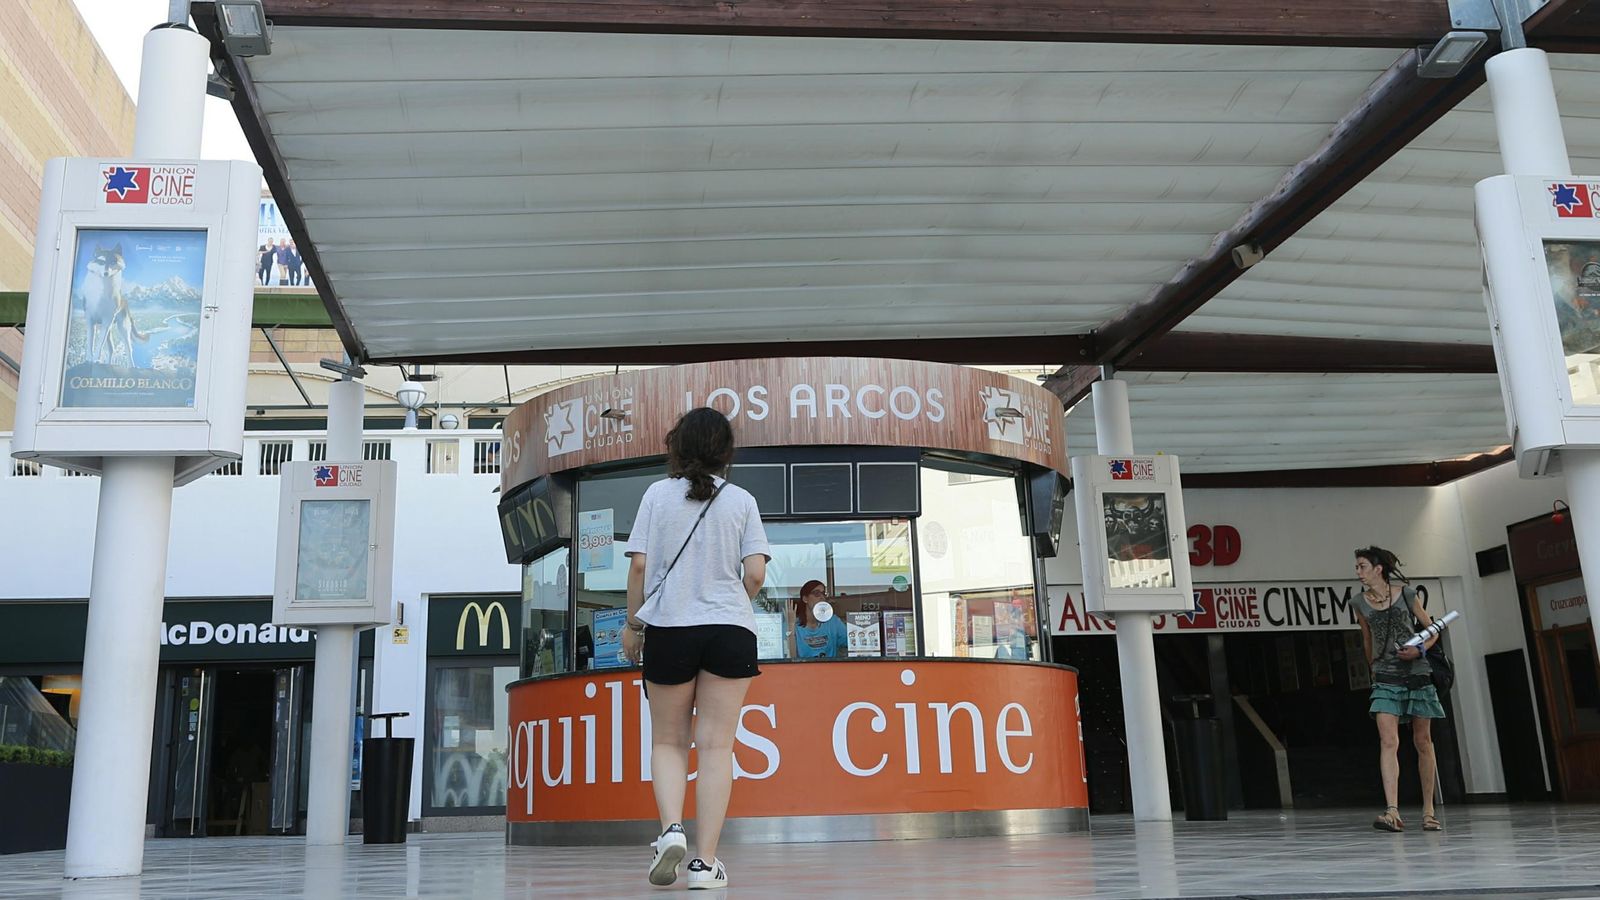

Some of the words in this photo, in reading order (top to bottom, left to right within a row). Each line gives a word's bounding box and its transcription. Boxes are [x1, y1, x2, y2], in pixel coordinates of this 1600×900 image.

[151, 175, 194, 196] CINE
[70, 376, 136, 389] COLMILLO
[137, 377, 192, 390] BLANCO
[585, 386, 633, 404] UNION
[790, 383, 945, 423] ARCOS
[585, 398, 633, 438] CINE
[1023, 405, 1051, 445] CINE
[585, 433, 633, 449] CIUDAD
[1024, 438, 1052, 455] CIUDAD
[340, 469, 362, 482] CINE
[1133, 464, 1153, 476] CINE
[1187, 524, 1241, 566] 3D
[1214, 587, 1257, 596] UNION
[1216, 596, 1260, 620] CINE
[1218, 620, 1261, 628] CIUDAD
[831, 669, 1034, 777] cine
